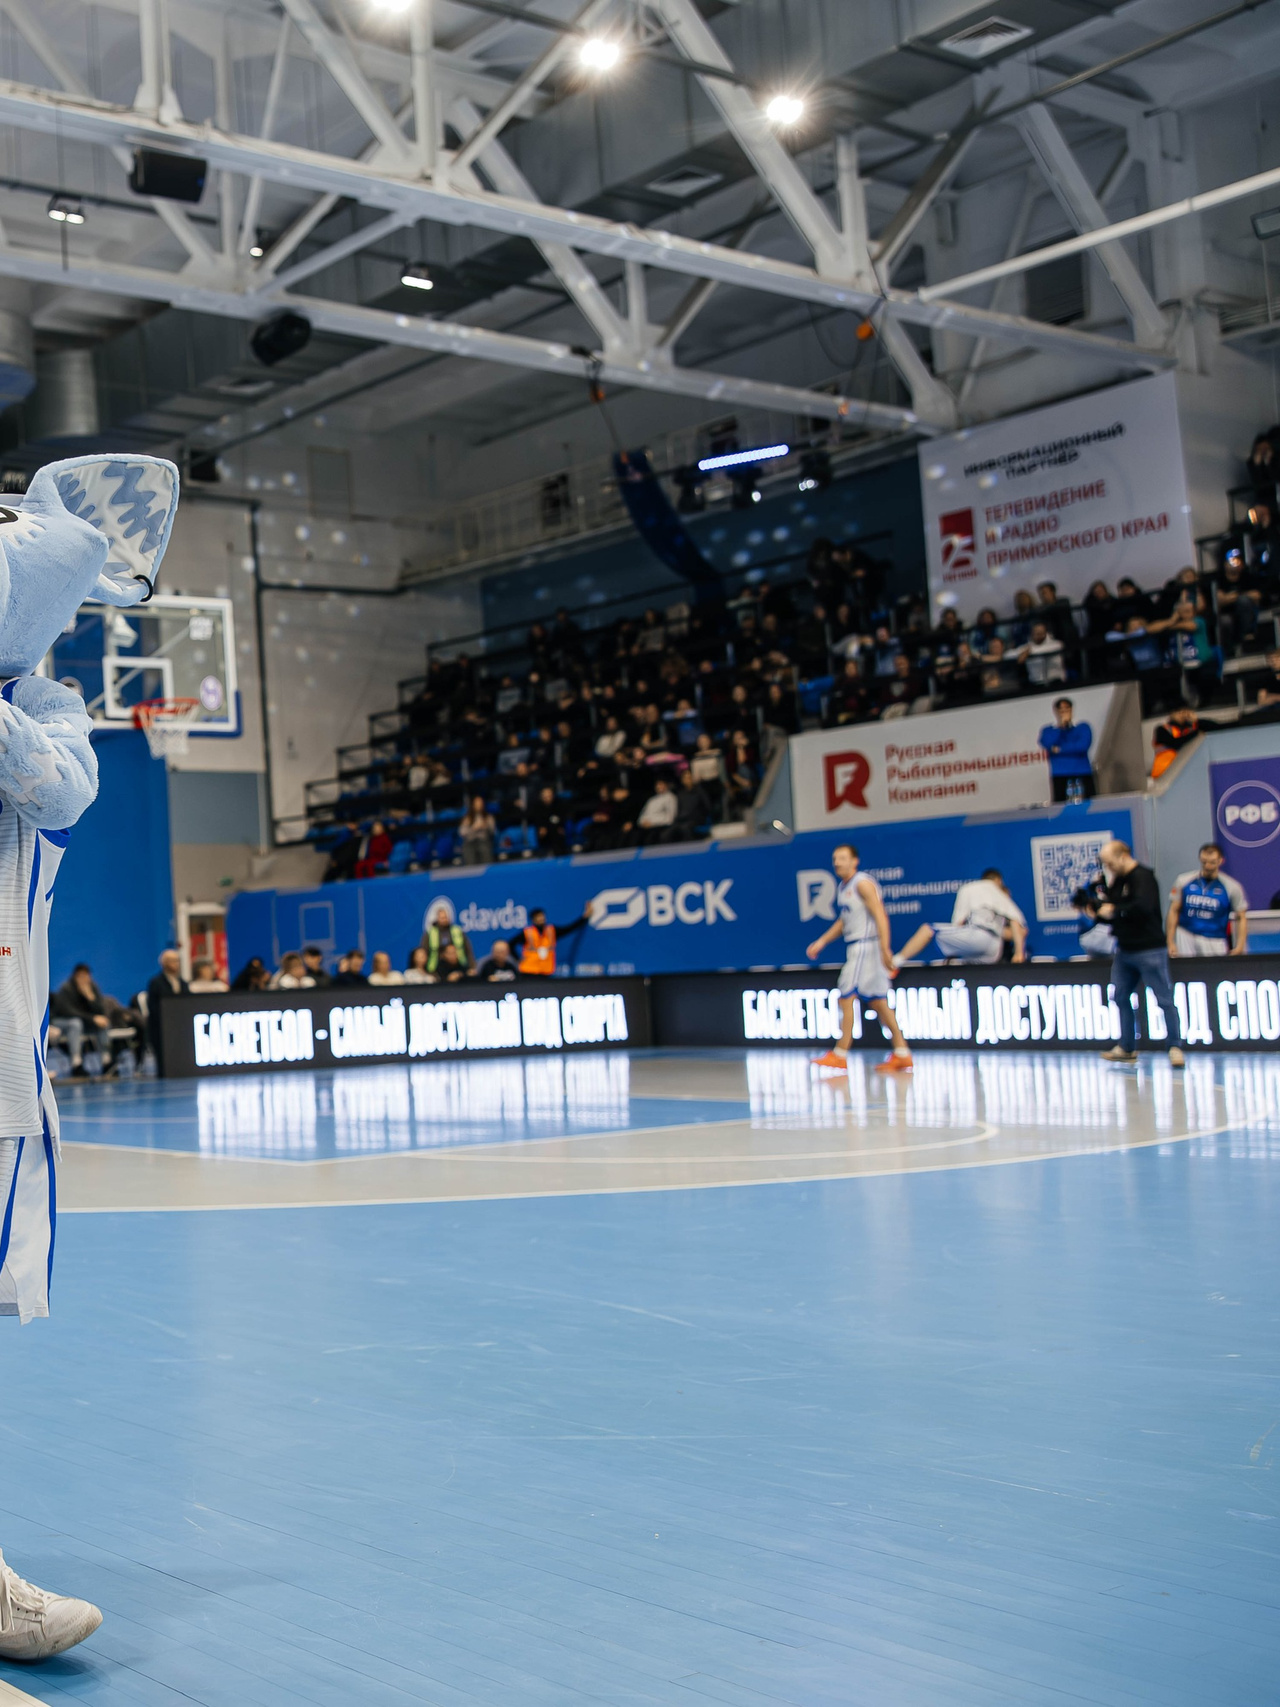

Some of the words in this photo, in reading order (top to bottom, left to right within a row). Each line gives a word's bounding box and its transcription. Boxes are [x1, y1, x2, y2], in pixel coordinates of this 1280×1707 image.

[984, 479, 1106, 524] ТЕЛЕВИДЕНИЕ
[986, 524, 1117, 569] ПРИМОРСКОГО
[1121, 512, 1170, 540] КРАЯ
[1001, 514, 1060, 542] РАДИО
[885, 739, 956, 764] Русская
[888, 780, 978, 805] Компания
[1225, 801, 1279, 827] РФБ
[646, 878, 738, 926] ВСК
[194, 1008, 314, 1067] БАСКЕТБОЛ
[329, 997, 407, 1059] САМЫЙ
[408, 992, 521, 1057] ДОСТУПНЫЙ
[975, 983, 1141, 1044] ДОСТУПНЫ
